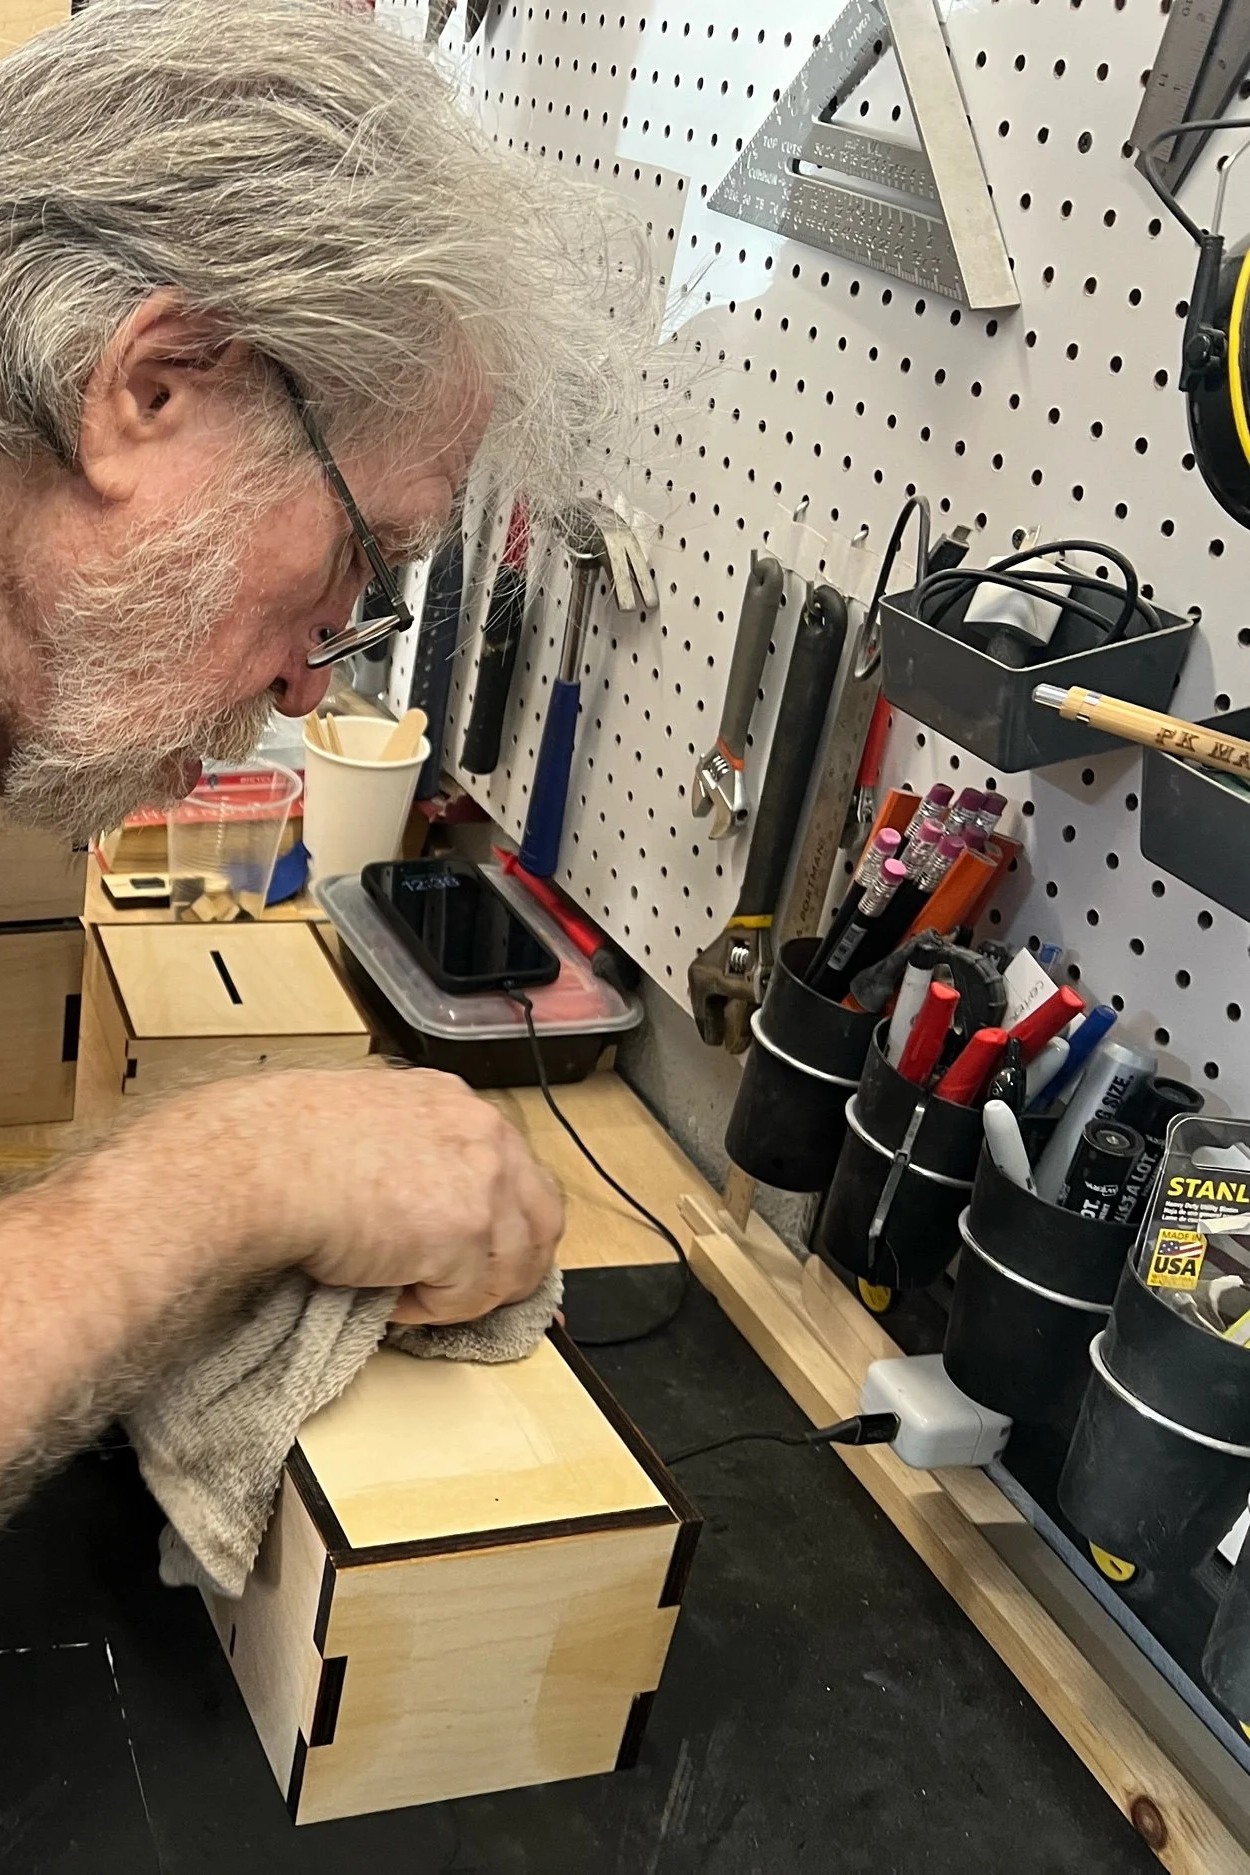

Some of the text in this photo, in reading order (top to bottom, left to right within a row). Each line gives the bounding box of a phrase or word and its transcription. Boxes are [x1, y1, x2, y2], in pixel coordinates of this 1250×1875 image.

[781, 141, 802, 157] CUTS
[1102, 1075, 1134, 1108] SIZE.
[1130, 1152, 1158, 1184] LOT.
[1167, 1177, 1250, 1203] STANL
[1080, 1199, 1100, 1219] OT.
[1161, 1230, 1190, 1240] MADE
[1153, 1256, 1197, 1277] USA
